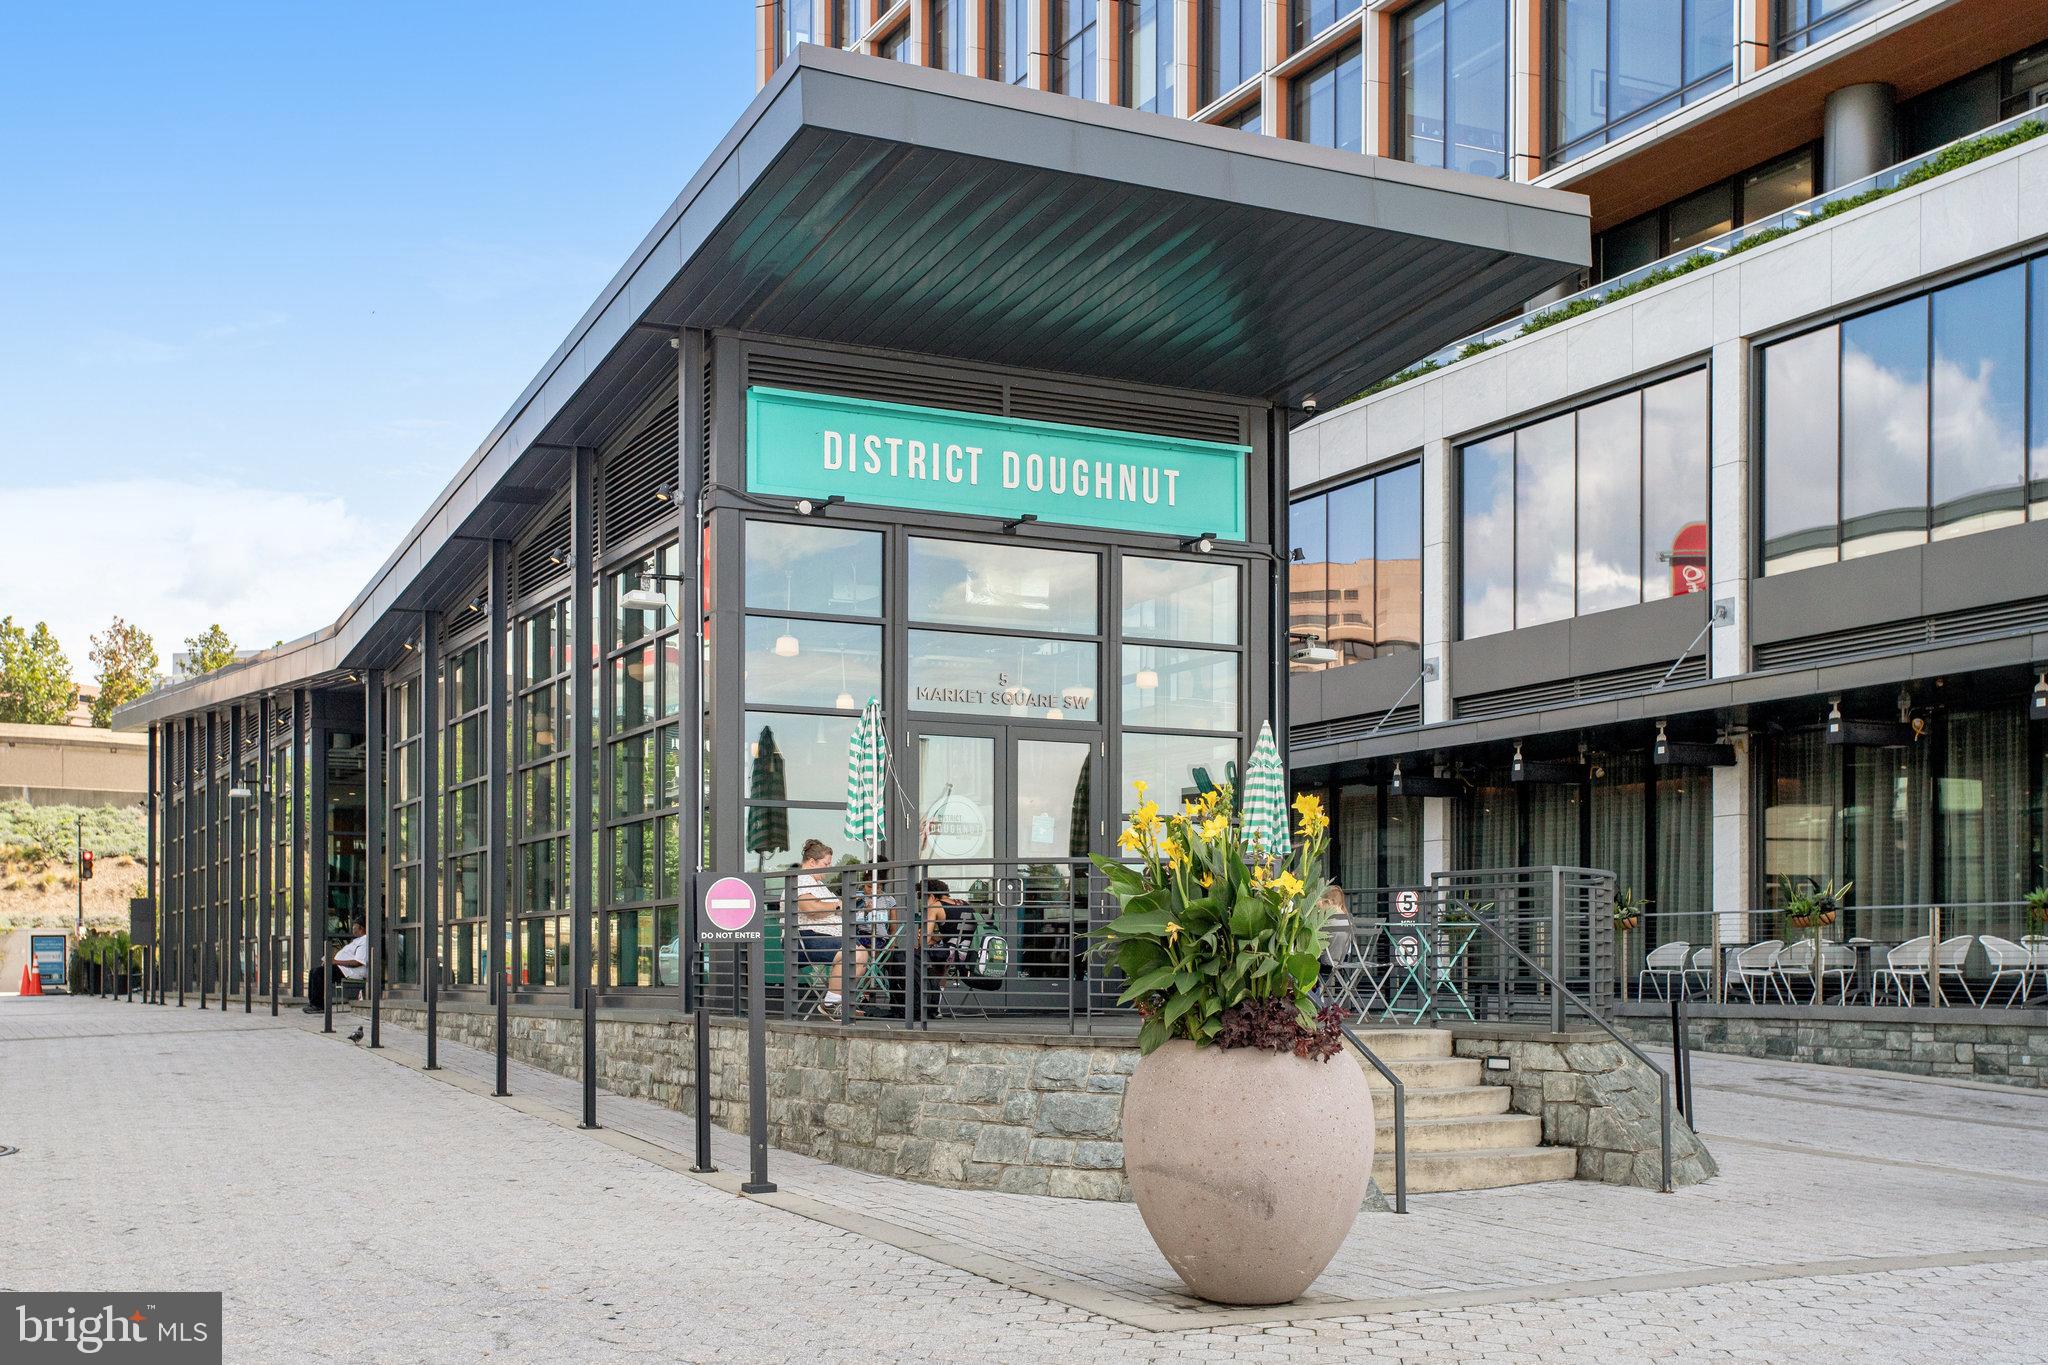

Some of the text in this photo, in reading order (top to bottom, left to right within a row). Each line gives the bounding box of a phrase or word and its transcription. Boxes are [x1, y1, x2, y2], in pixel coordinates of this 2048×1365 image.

[823, 430, 1180, 506] DISTRICT DOUGHNUT
[999, 672, 1009, 687] 5
[916, 686, 1091, 710] MARKET SQUARE SW
[1403, 894, 1412, 911] 5
